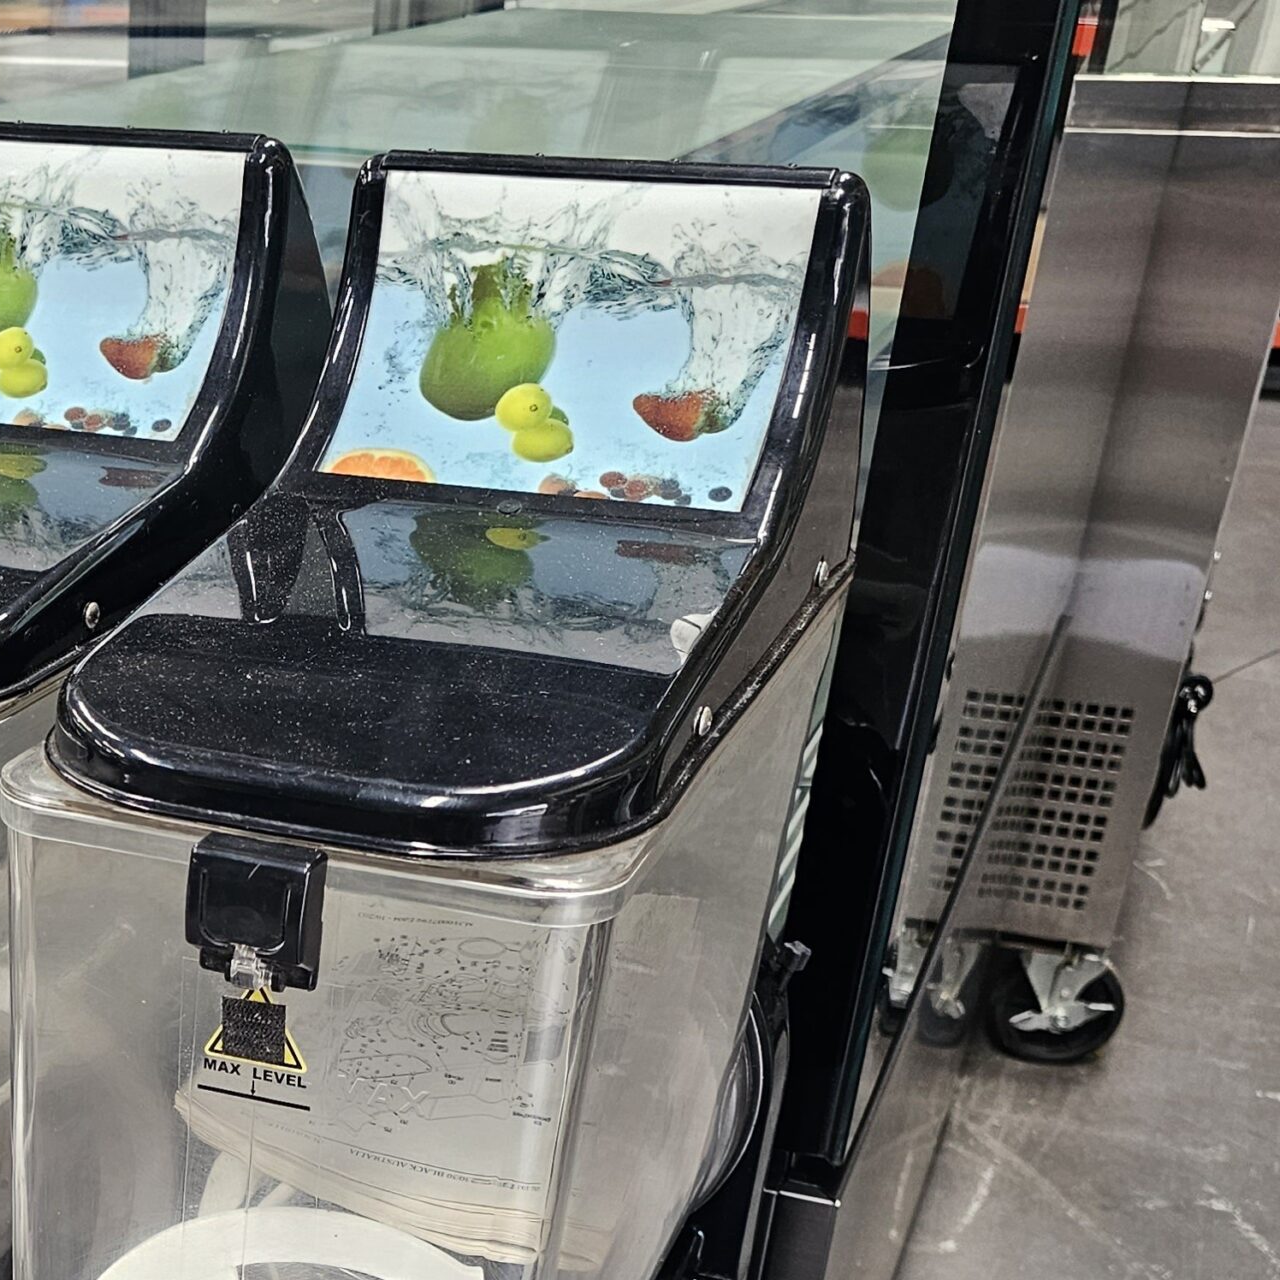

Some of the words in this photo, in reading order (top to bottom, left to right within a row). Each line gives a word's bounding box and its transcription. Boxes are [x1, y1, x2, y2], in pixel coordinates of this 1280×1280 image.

[202, 1057, 241, 1076] MAX
[252, 1067, 308, 1089] LEVEL
[348, 1147, 407, 1168] AUSTRALIA
